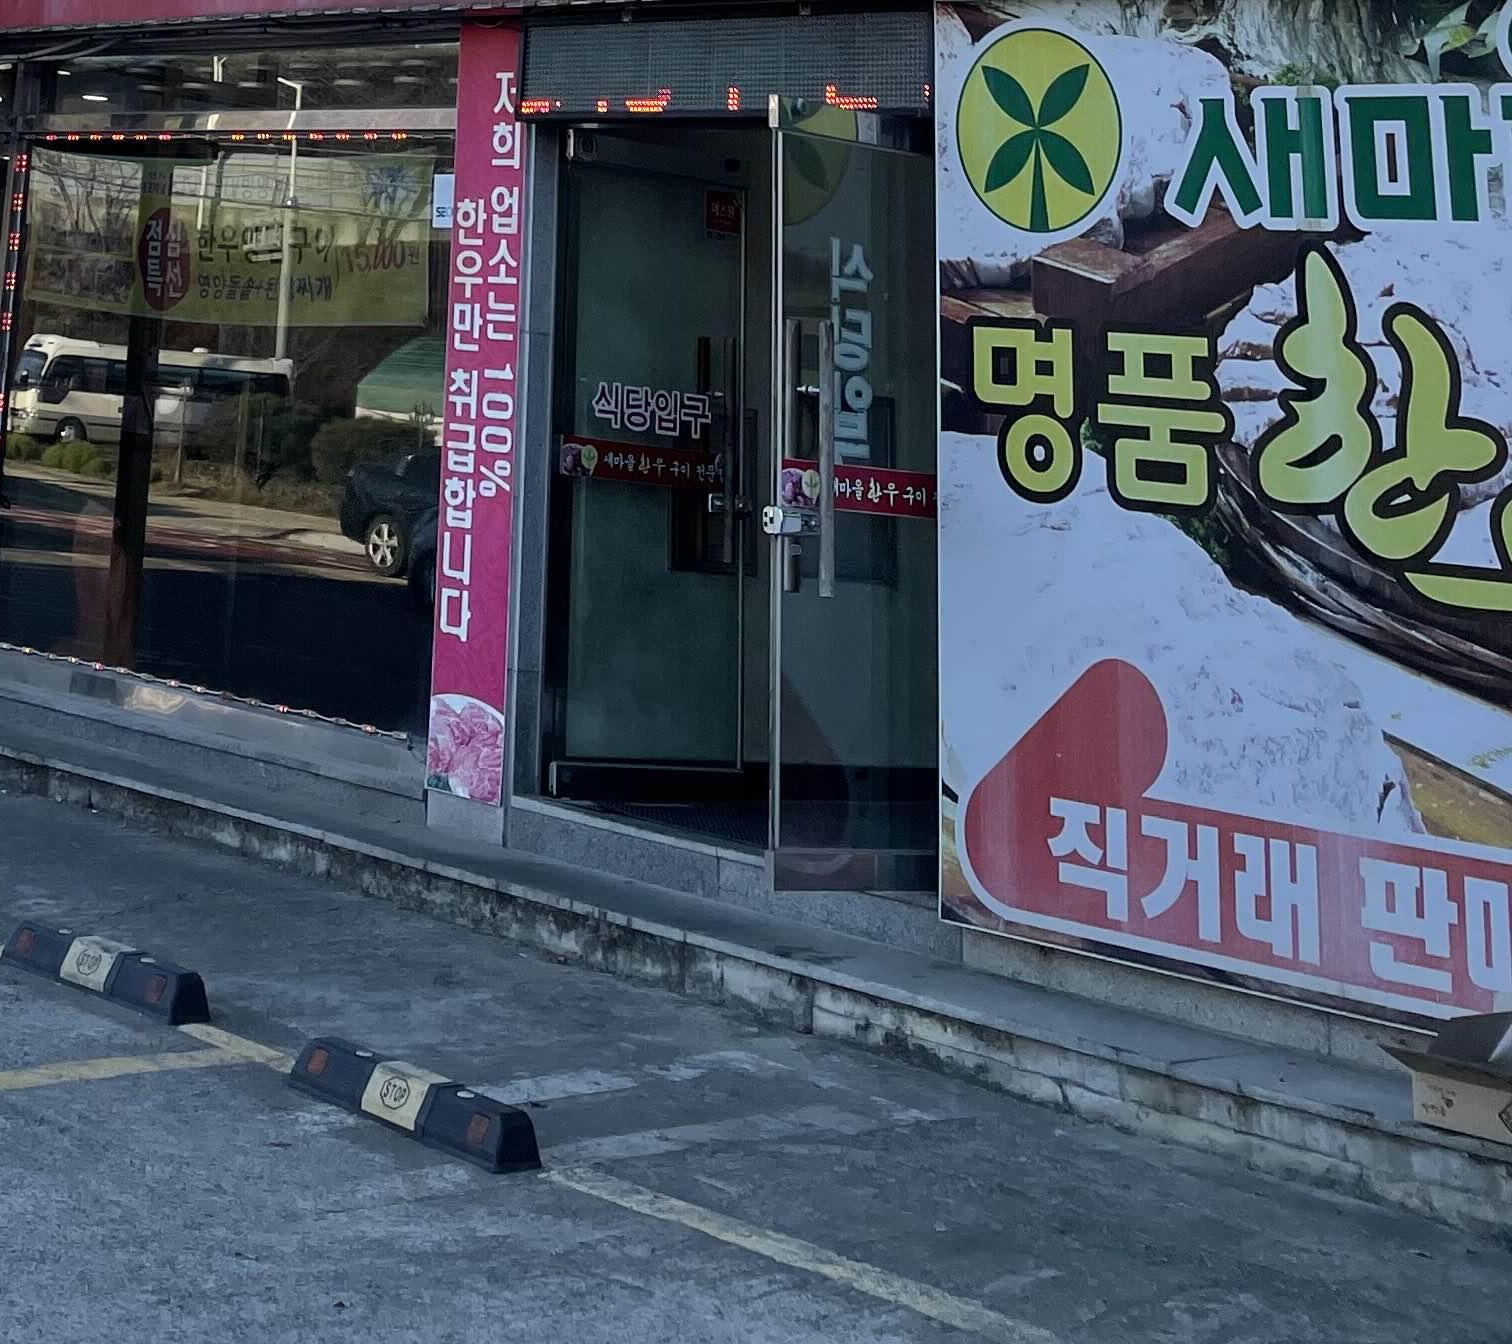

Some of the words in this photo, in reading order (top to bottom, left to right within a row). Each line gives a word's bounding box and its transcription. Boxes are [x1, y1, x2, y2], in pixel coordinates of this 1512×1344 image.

[1166, 83, 1512, 231] 새마
[452, 198, 487, 352] 한우만
[488, 185, 519, 341] 업소는
[479, 364, 513, 500] 100%
[592, 381, 712, 440] 식당입구
[966, 315, 1235, 512] 명품
[1252, 238, 1512, 612] 한
[439, 367, 478, 643] 취급합니다
[868, 477, 899, 507] 한우
[1046, 795, 1321, 969] 직거래
